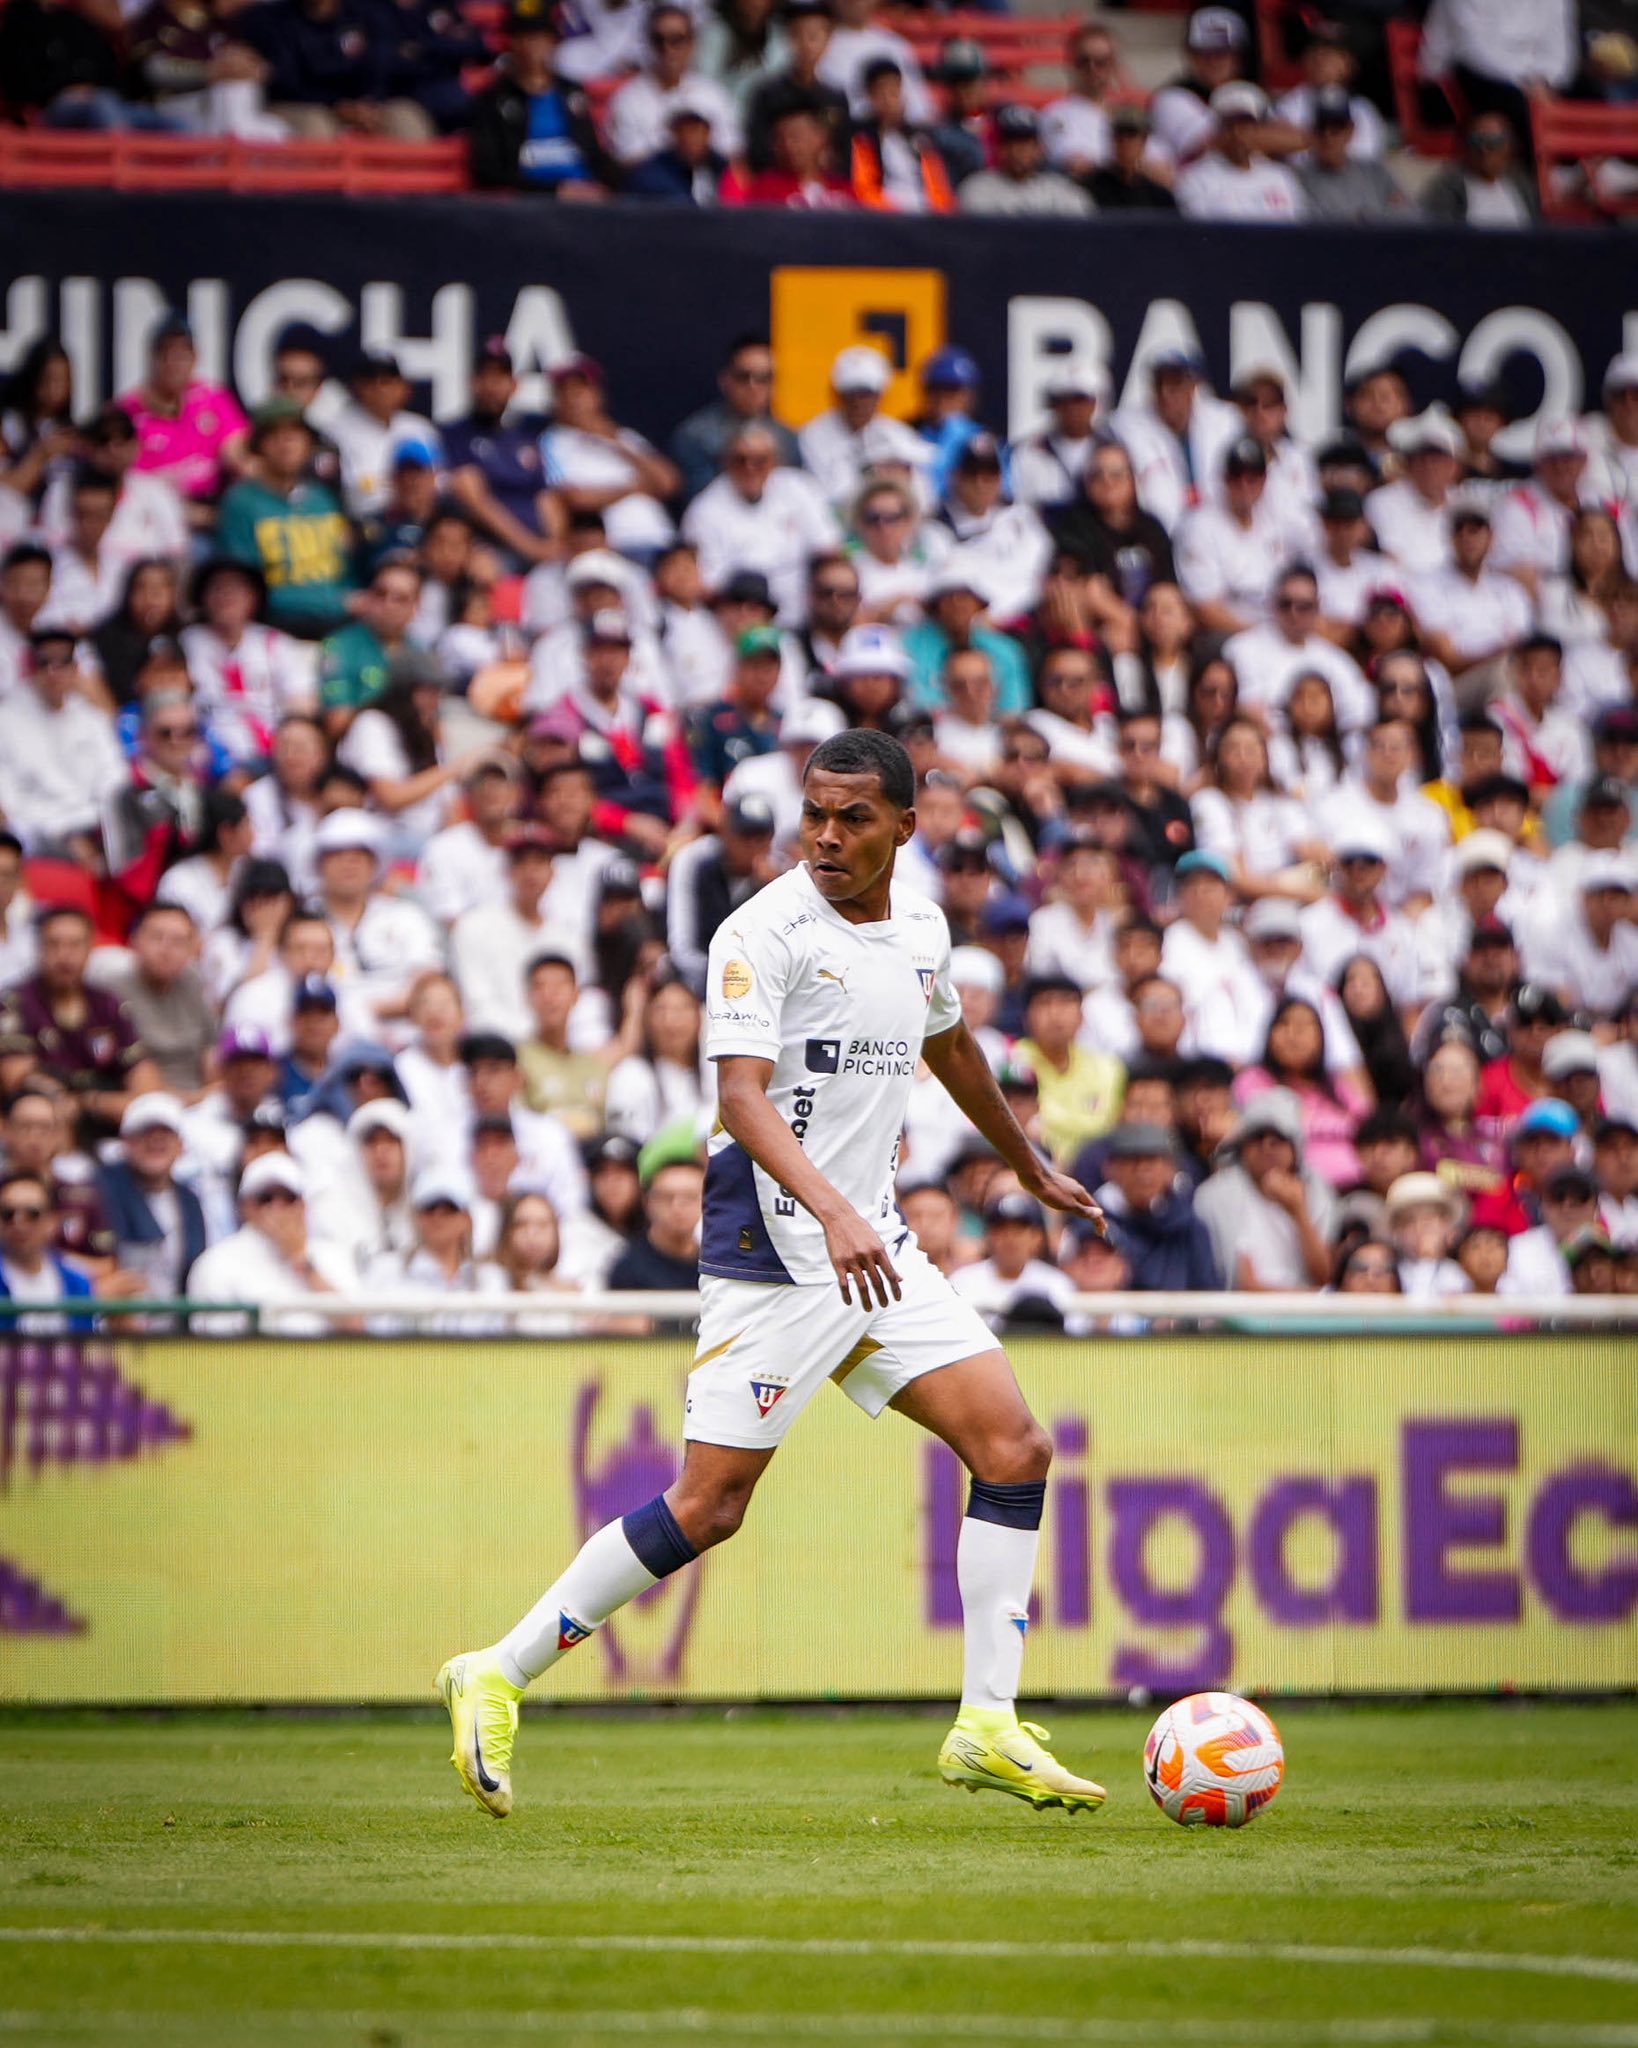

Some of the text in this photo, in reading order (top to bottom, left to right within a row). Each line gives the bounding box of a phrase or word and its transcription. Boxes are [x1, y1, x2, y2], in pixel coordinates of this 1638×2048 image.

[1007, 295, 1582, 460] BANCO
[848, 1040, 908, 1056] BANCO
[775, 1086, 817, 1217] Ecbet
